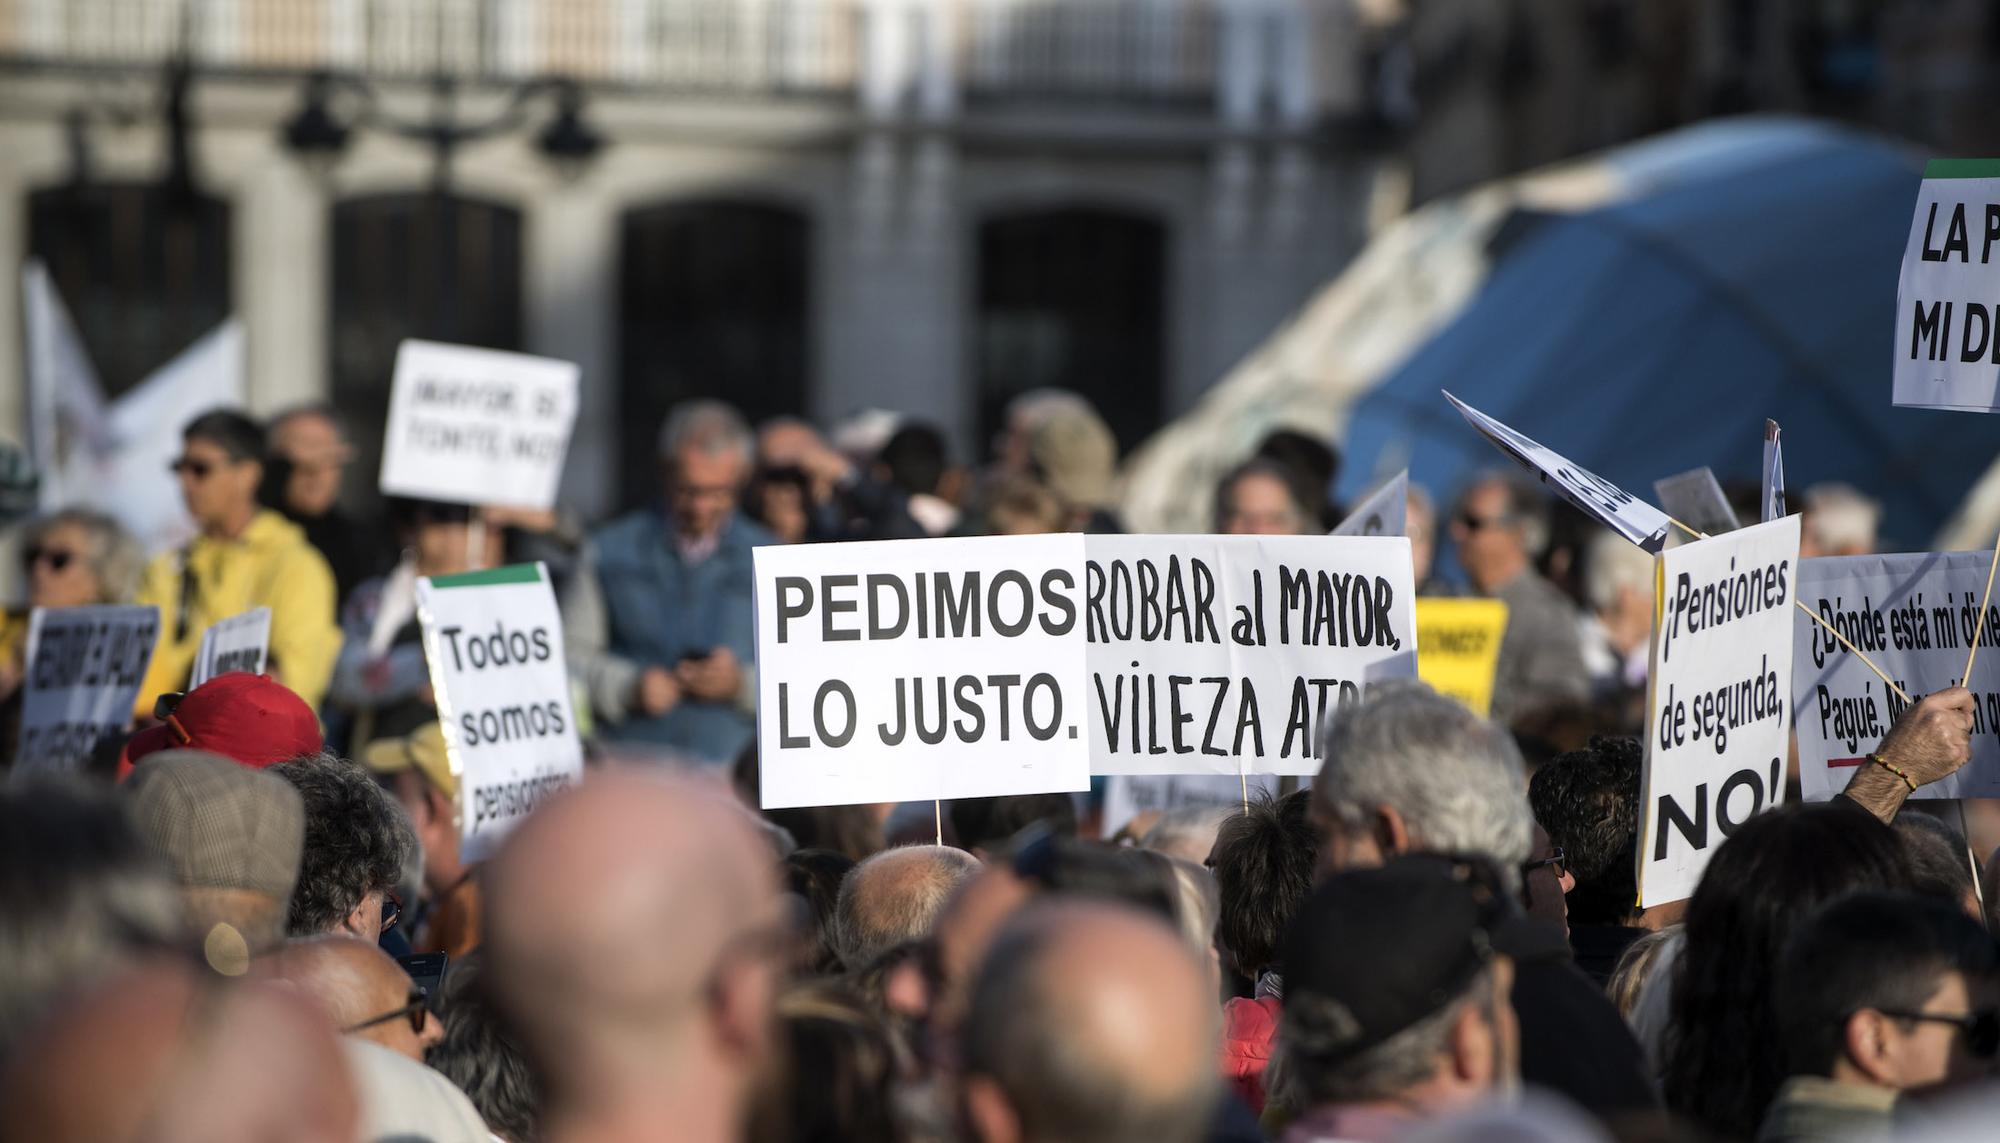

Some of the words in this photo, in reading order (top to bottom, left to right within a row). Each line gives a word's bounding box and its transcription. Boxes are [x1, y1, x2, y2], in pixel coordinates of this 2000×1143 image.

[1921, 202, 1969, 263] LA
[1911, 300, 1953, 362] MI
[775, 568, 1077, 643] PEDIMOS
[1086, 554, 1221, 644] ROBAR
[1231, 569, 1266, 646] al
[1279, 564, 1400, 651] MAYOR,
[1664, 556, 1788, 663] ¡Pensiones
[1812, 596, 1887, 669] ¿Dónde
[1890, 593, 1931, 650] está
[1933, 592, 1959, 649] mi
[442, 618, 551, 673] Todos
[461, 700, 566, 747] somos
[778, 679, 857, 749] LO
[877, 672, 1079, 747] JUSTO.
[1660, 684, 1685, 751] de
[1692, 654, 1783, 755] segunda,
[1817, 681, 1884, 754] Pagué.
[1654, 757, 1781, 861] NO!
